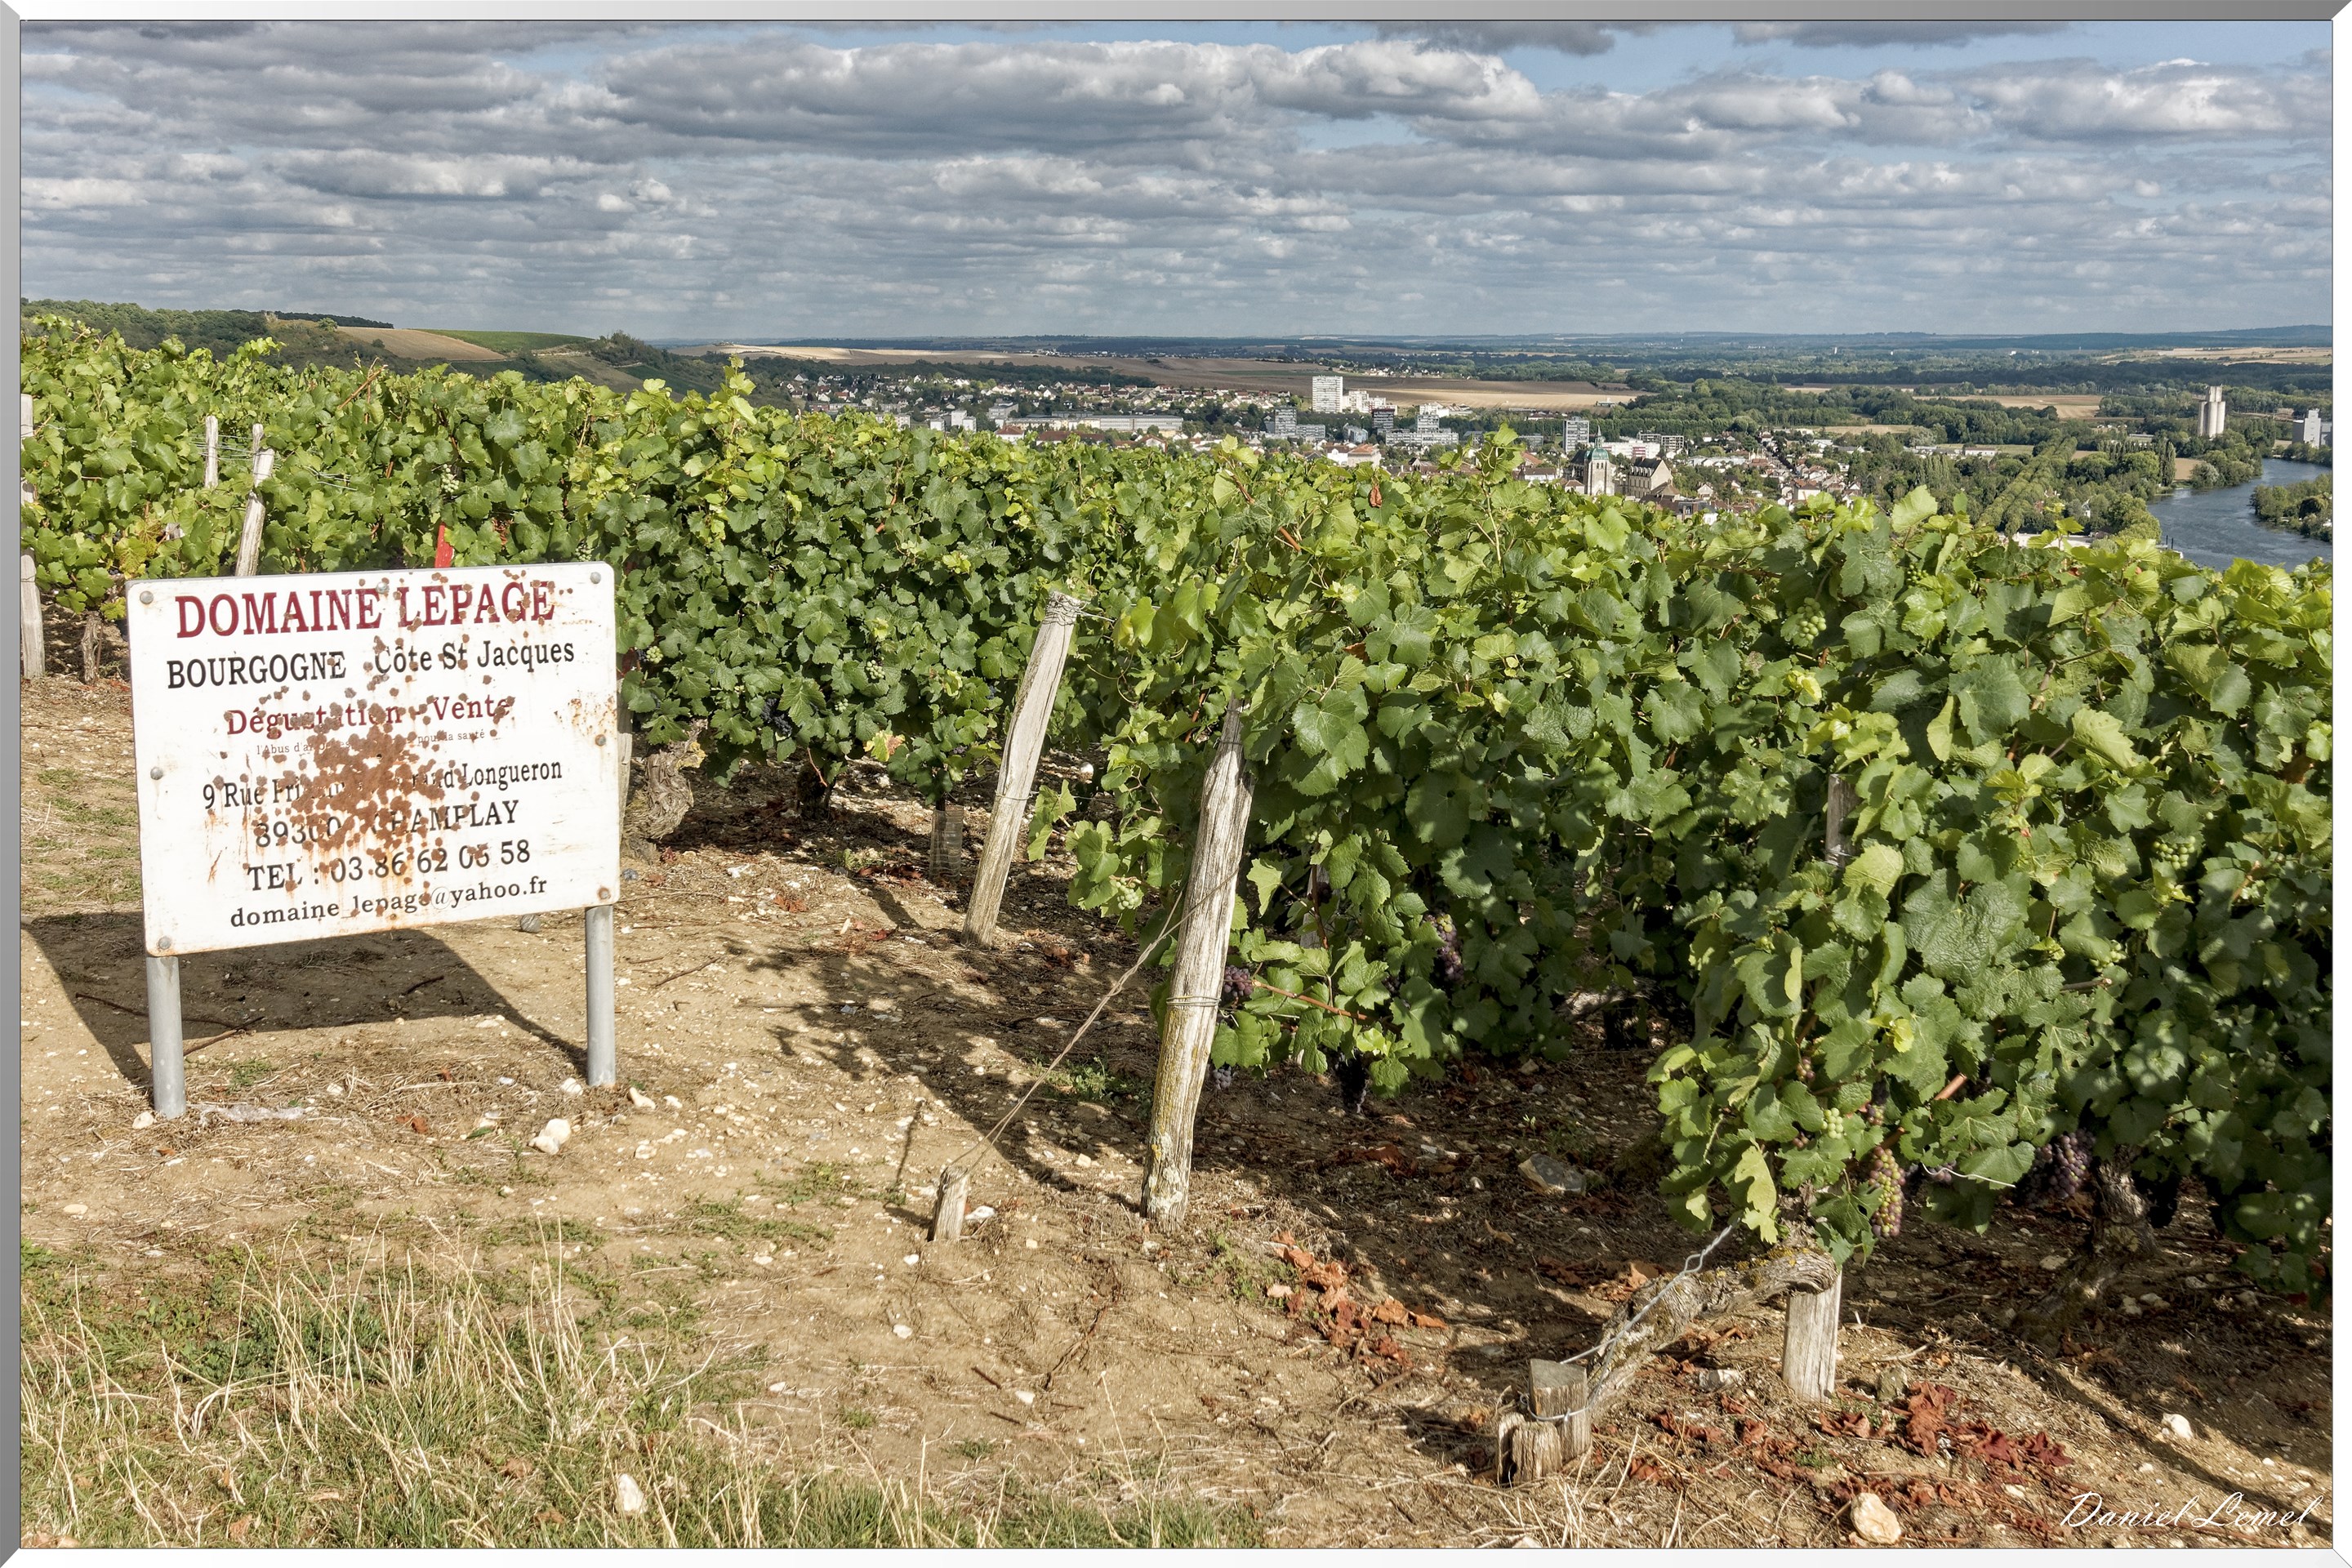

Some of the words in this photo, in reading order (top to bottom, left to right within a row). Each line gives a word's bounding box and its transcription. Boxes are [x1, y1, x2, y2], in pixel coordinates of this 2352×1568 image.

[175, 588, 383, 639] DOMAINE
[397, 581, 555, 628] LEPAGE
[167, 651, 346, 689] BOURGOGNE
[375, 644, 432, 674] Côte
[442, 642, 468, 670] St
[477, 640, 575, 673] Jacques
[226, 703, 403, 740] Déguttin
[432, 694, 513, 720] Vente
[417, 732, 442, 745] pou
[203, 783, 216, 810] 9
[224, 782, 268, 808] Rue
[461, 761, 563, 791] Longueron
[371, 799, 519, 835] HAMPLAY
[247, 862, 303, 892] TEL
[501, 840, 531, 865] 58
